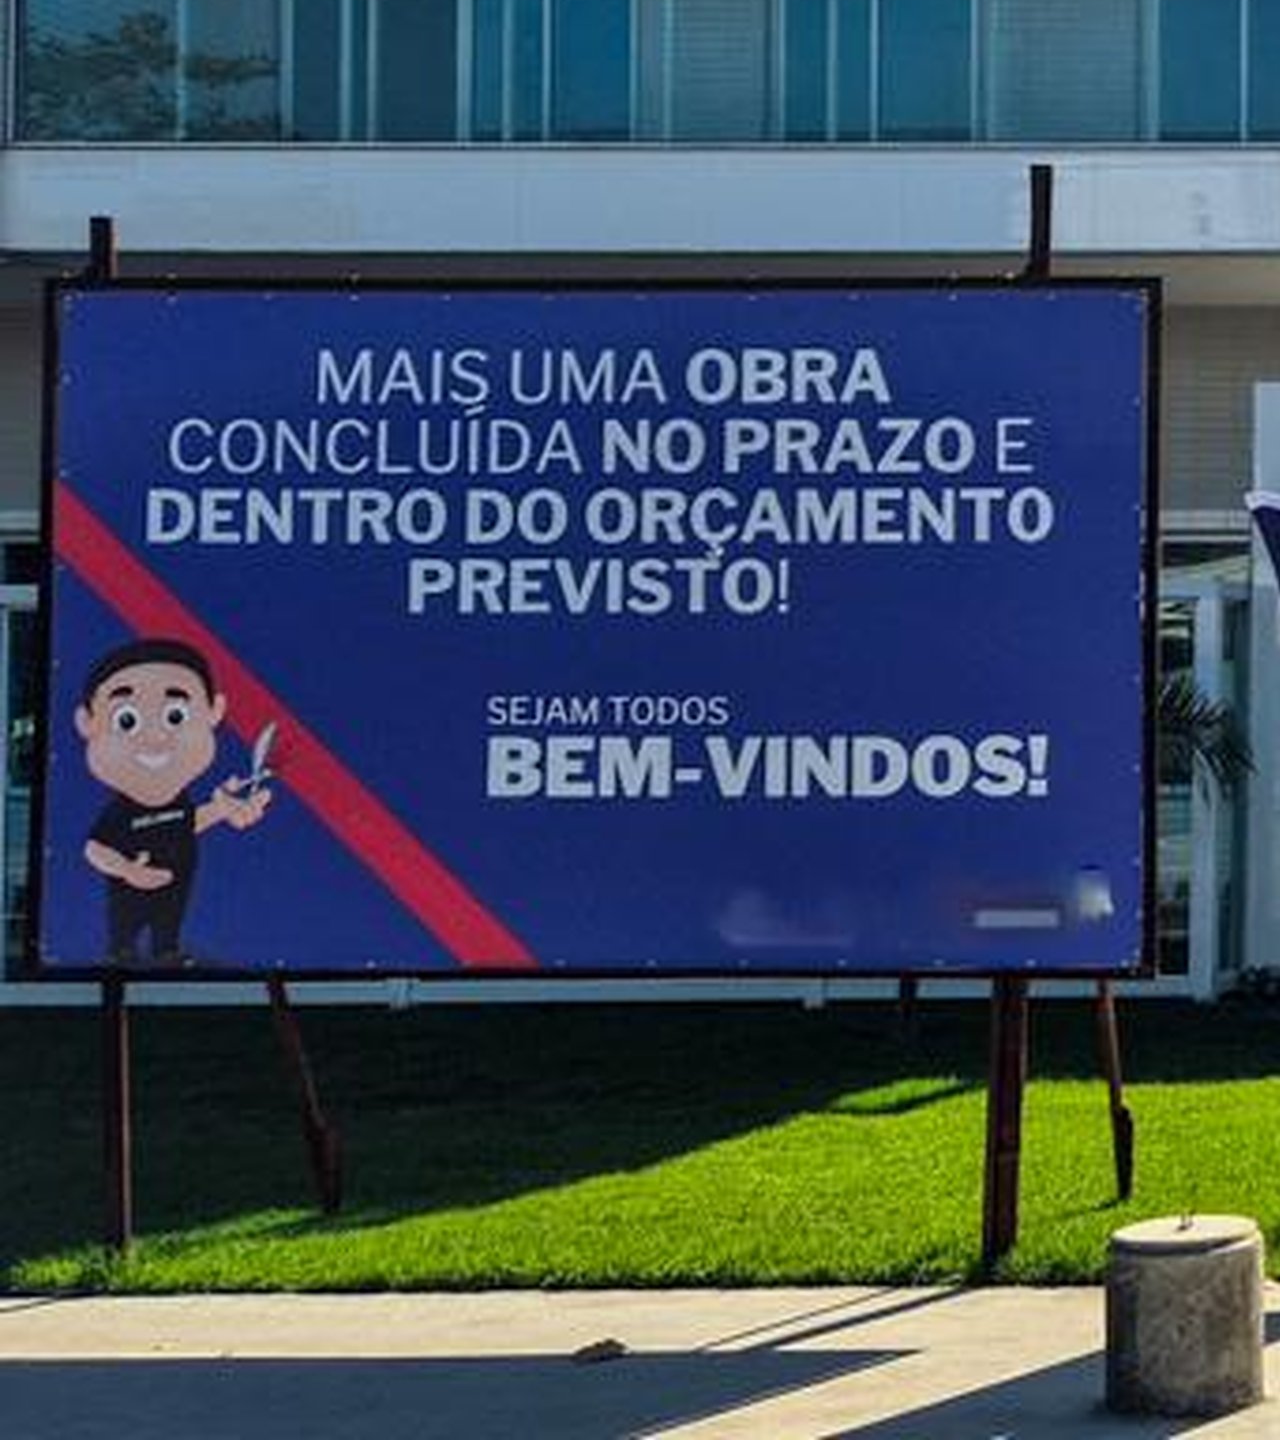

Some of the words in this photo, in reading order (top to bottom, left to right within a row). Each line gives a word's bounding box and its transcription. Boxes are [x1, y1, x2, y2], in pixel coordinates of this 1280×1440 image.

[317, 349, 489, 405] MAIS
[511, 349, 667, 404] UMA
[686, 348, 891, 404] OBRA
[169, 405, 582, 474] CONCLUÍDA
[603, 419, 705, 474] NO
[724, 418, 975, 474] PRAZO
[997, 417, 1034, 473] E
[147, 488, 447, 544] DENTRO
[466, 489, 568, 544] DO
[585, 486, 1054, 558] ORÇAMENTO
[409, 558, 789, 614] PREVISTO!
[488, 696, 599, 725] SEJAM
[609, 696, 729, 725] TODOS
[487, 734, 1048, 798] BEM-VINDOS!
